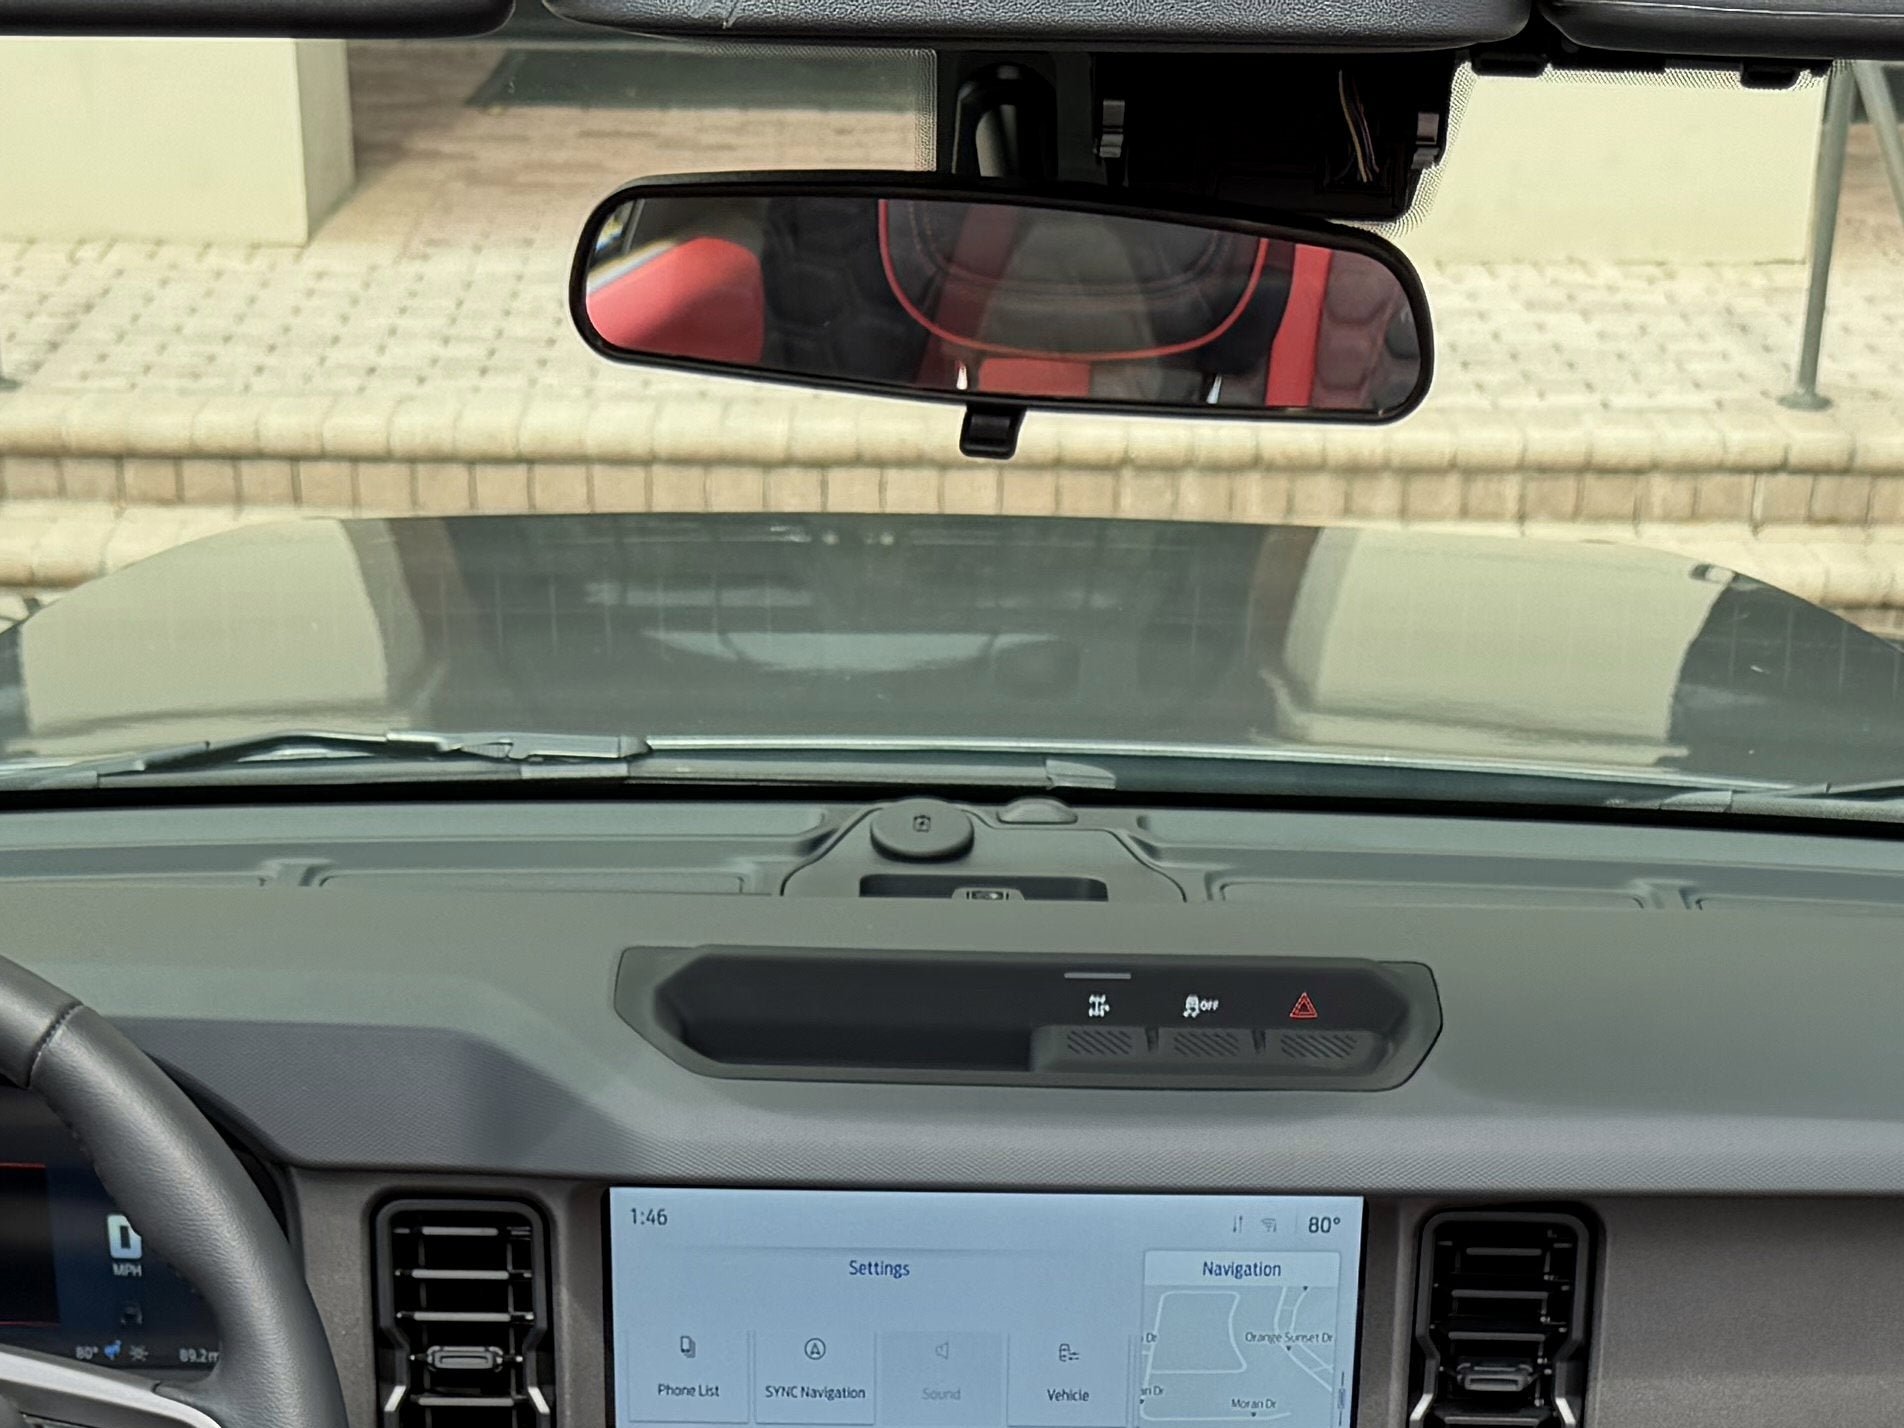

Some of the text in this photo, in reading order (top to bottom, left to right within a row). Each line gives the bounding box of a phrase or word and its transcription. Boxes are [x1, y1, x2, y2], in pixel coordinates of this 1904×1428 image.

[630, 1207, 668, 1226] 1:46
[1308, 1216, 1341, 1234] 80°
[112, 1263, 142, 1277] MPH
[848, 1259, 910, 1279] Settings
[1202, 1260, 1281, 1279] Navigation
[1245, 1332, 1333, 1345] Orange Sunset Dr
[657, 1384, 720, 1397] Phone List
[765, 1385, 866, 1401] SYNC Navigation
[922, 1387, 961, 1400] Sound
[1047, 1388, 1090, 1402] Vehicle
[1232, 1399, 1277, 1409] Moran Dr
